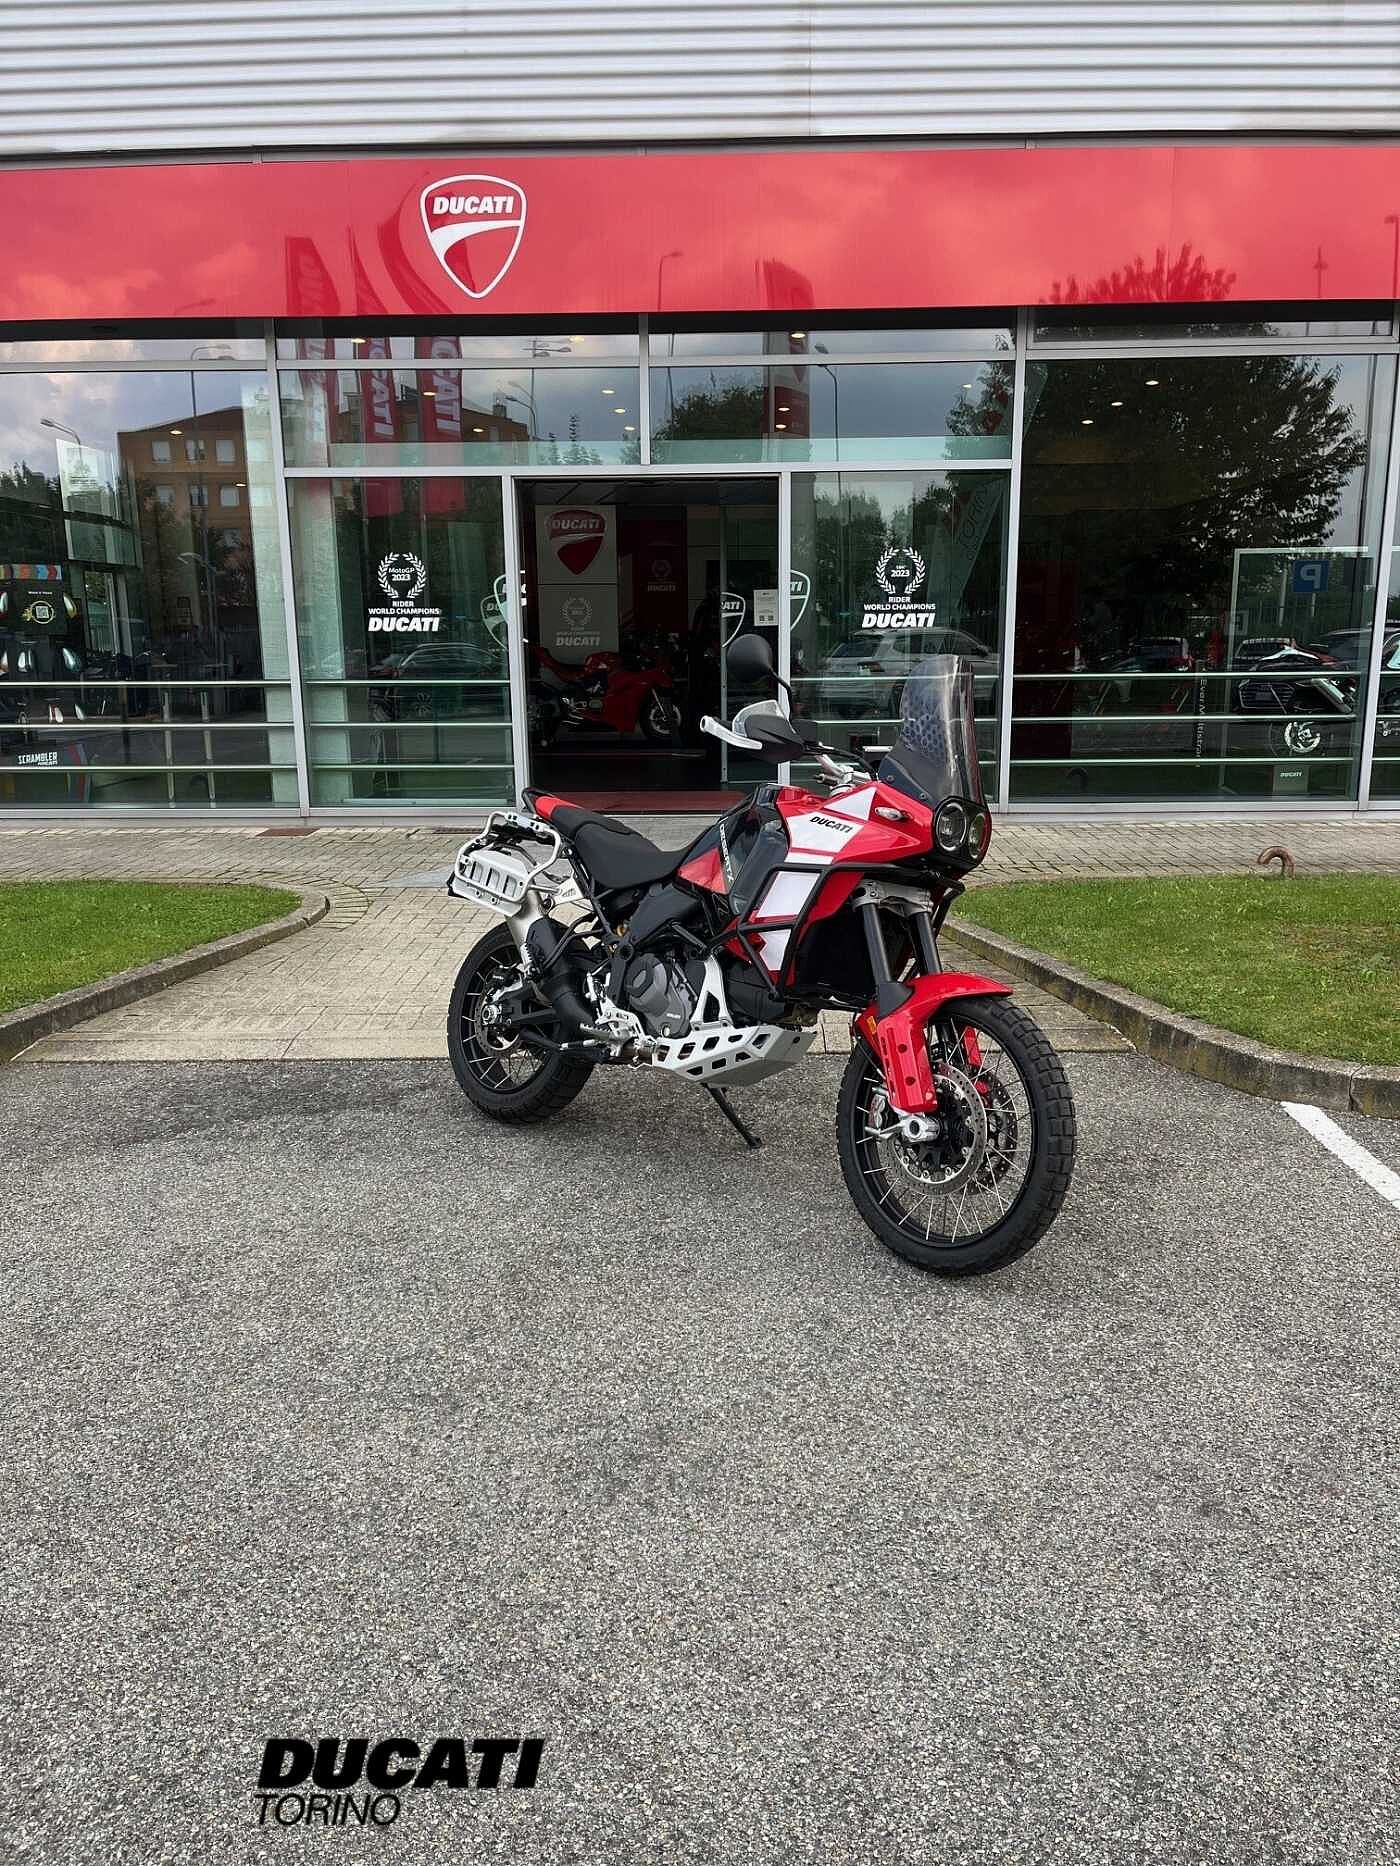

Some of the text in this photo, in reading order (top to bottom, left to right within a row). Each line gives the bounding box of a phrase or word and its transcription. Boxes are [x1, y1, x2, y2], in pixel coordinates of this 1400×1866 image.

[433, 196, 514, 214] DUCATI
[368, 617, 440, 632] DUCATI
[862, 613, 936, 628] DUCATI
[18, 752, 57, 765] SCRAMBLER
[810, 816, 853, 833] DUCATI
